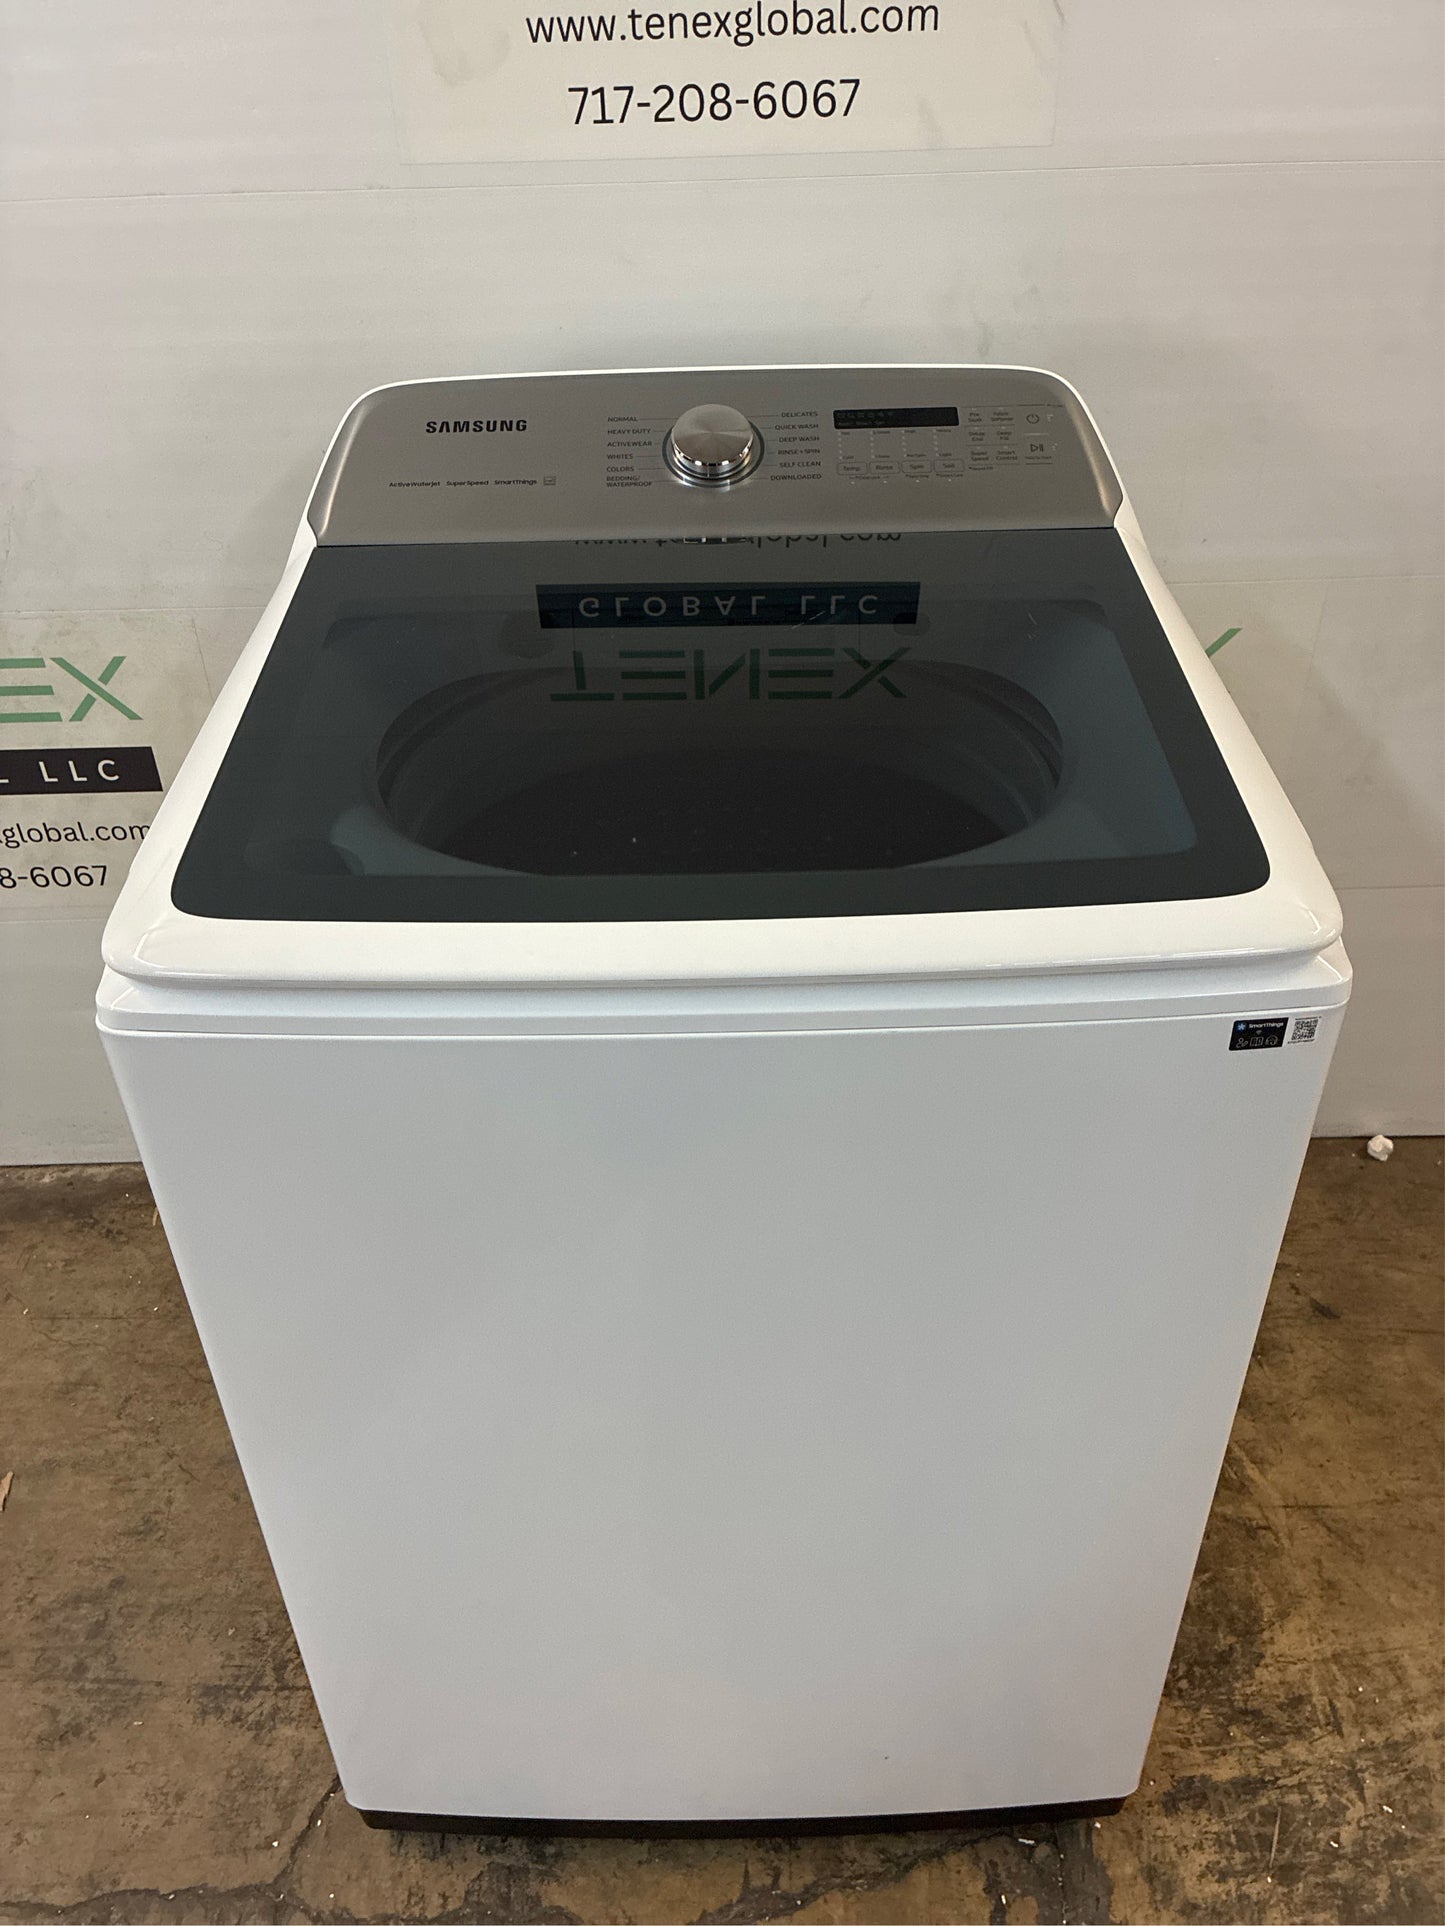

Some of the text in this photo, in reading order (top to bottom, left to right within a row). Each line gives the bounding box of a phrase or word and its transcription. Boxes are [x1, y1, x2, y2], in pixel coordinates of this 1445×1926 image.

[525, 0, 940, 47] www.tenexglobal.com
[567, 78, 861, 125] 717-208-6067
[425, 419, 528, 434] SAMSUNG
[770, 473, 823, 481] DOWNLOADED
[38, 759, 120, 782] LLC
[0, 821, 151, 849] global.com
